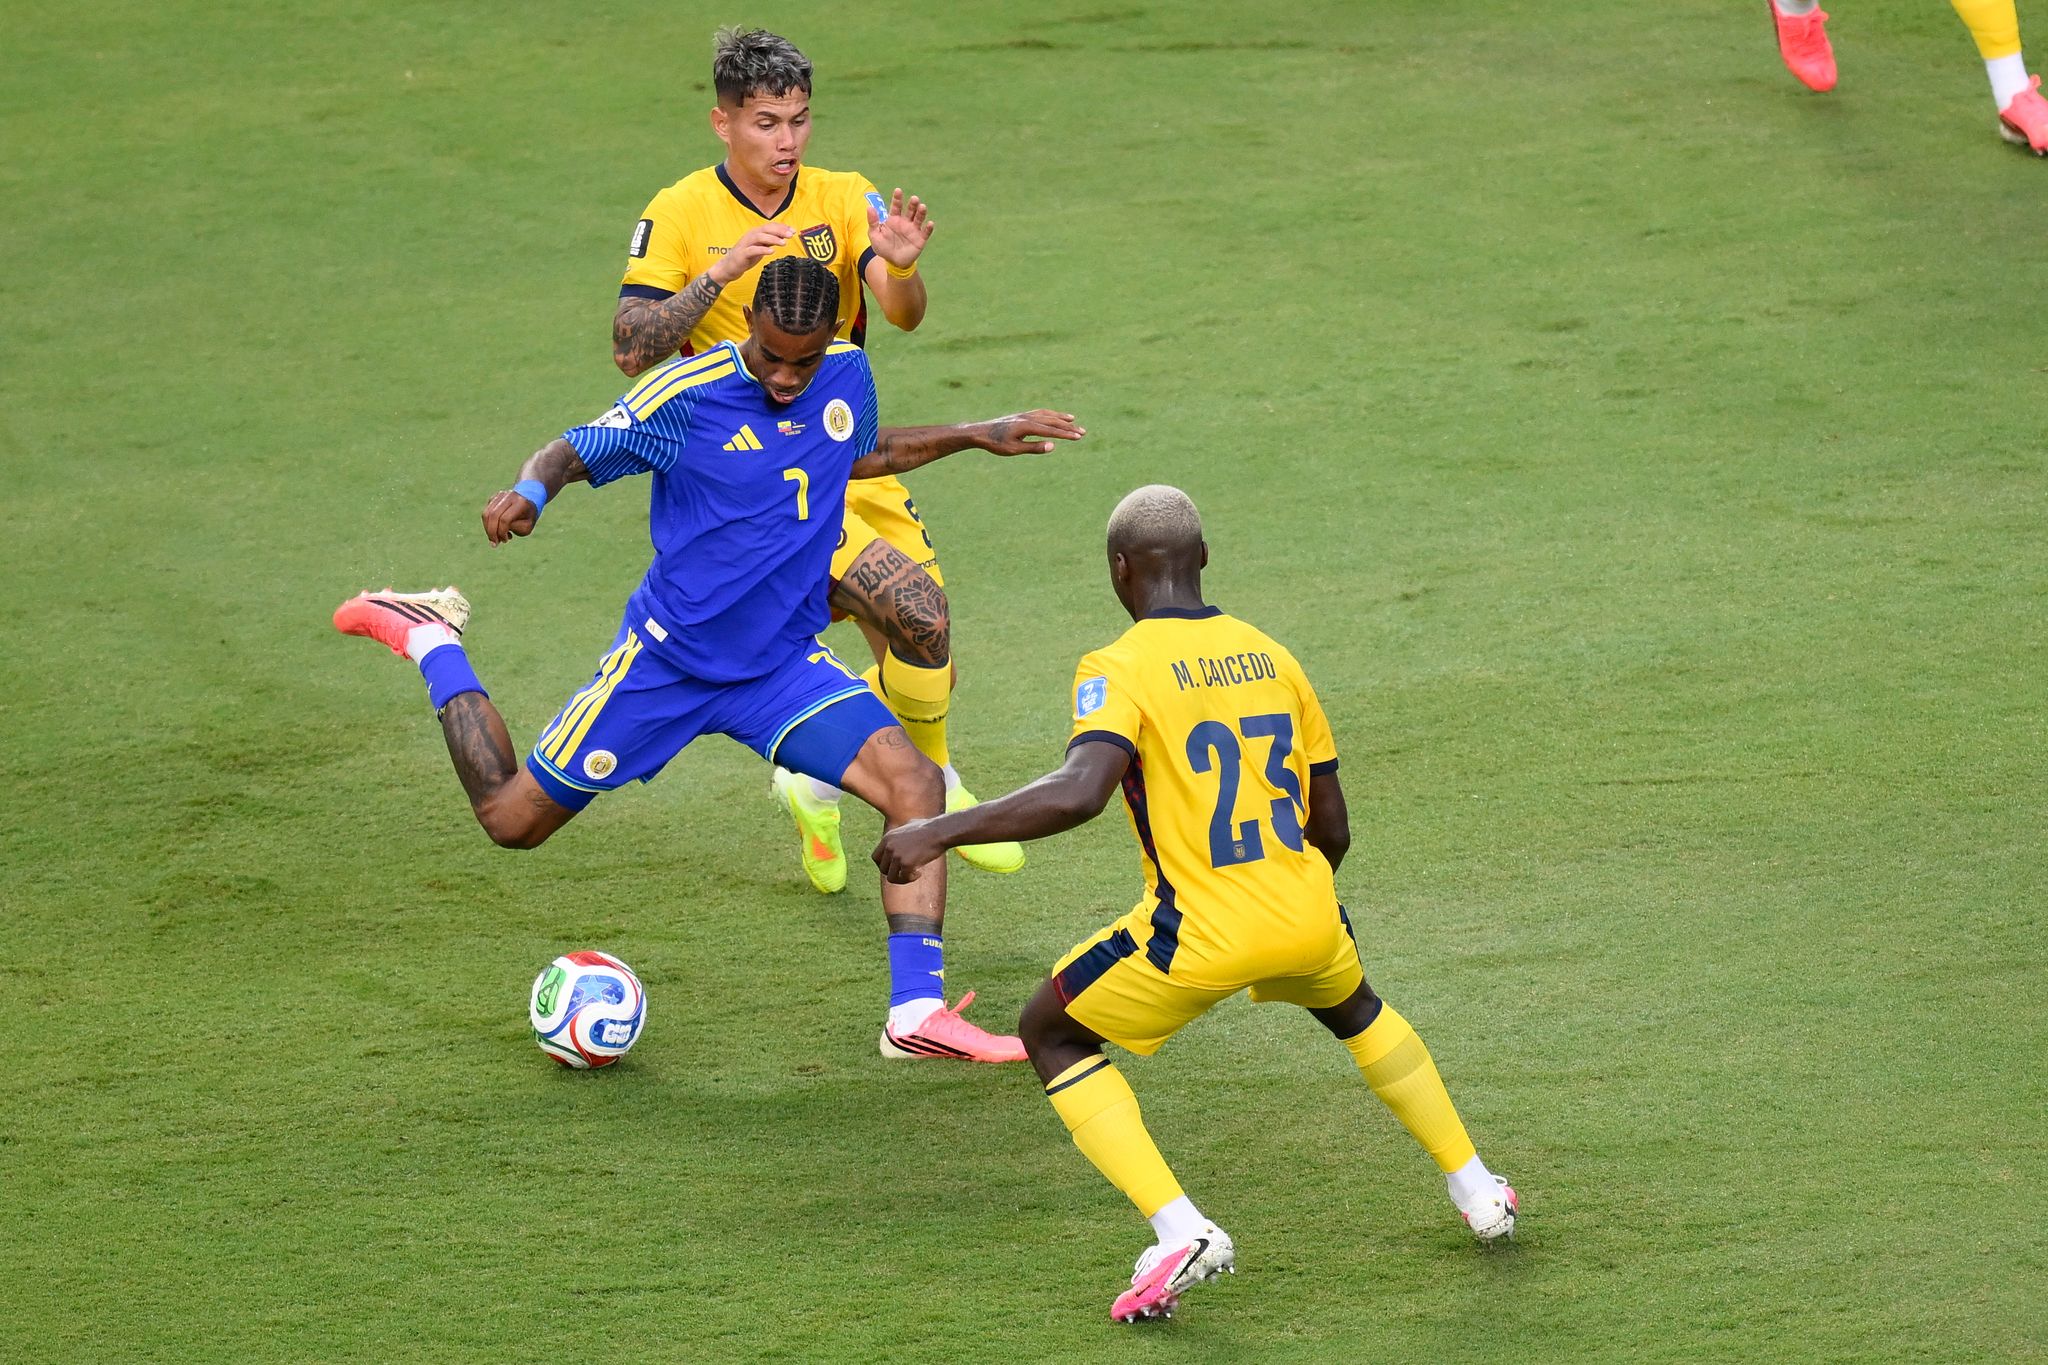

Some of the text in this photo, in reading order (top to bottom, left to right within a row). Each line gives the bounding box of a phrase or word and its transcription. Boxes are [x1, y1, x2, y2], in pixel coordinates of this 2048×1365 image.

[783, 467, 809, 521] 7
[806, 650, 859, 680] 7
[1171, 652, 1277, 691] M. CAICEDO
[1185, 713, 1305, 869] 23
